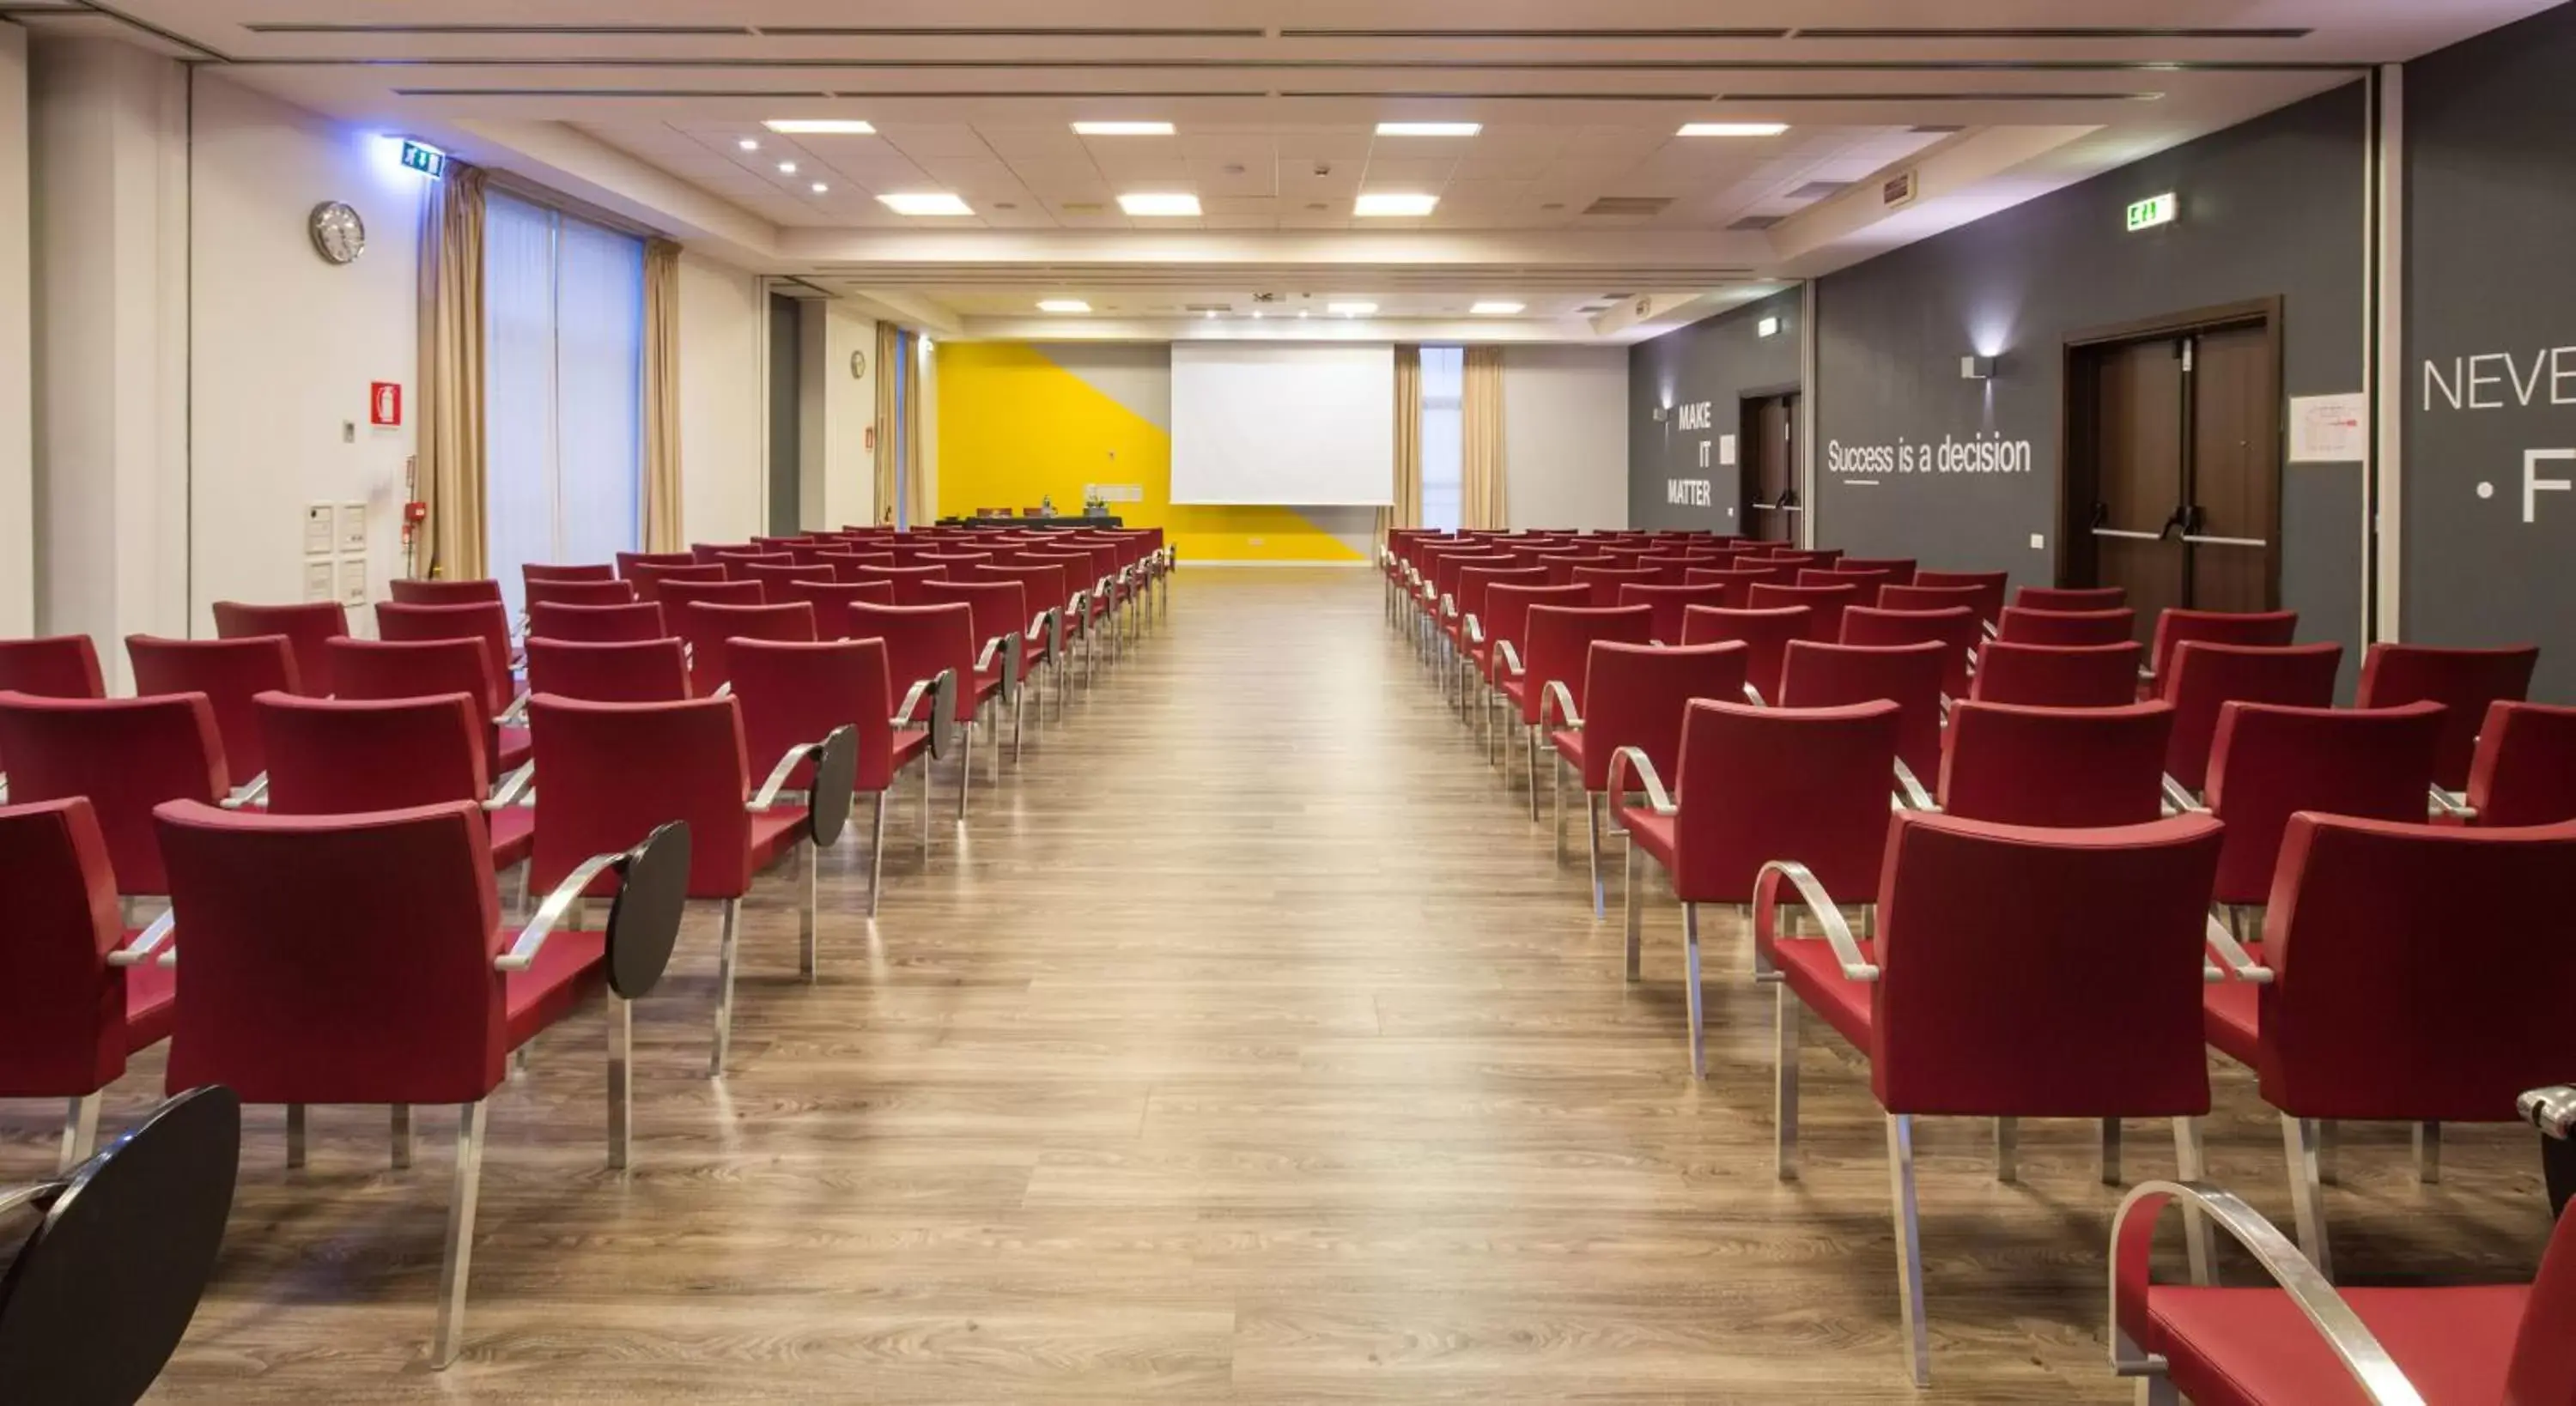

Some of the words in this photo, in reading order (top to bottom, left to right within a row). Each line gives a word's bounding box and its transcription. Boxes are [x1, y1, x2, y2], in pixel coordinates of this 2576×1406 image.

[1679, 401, 1712, 431] MAKE
[1699, 439, 1712, 468] IT
[1827, 439, 1894, 473] Success
[1899, 436, 1914, 473] is
[1918, 444, 1933, 473] a
[1937, 431, 2032, 473] decision
[1668, 478, 1711, 507] MATTER
